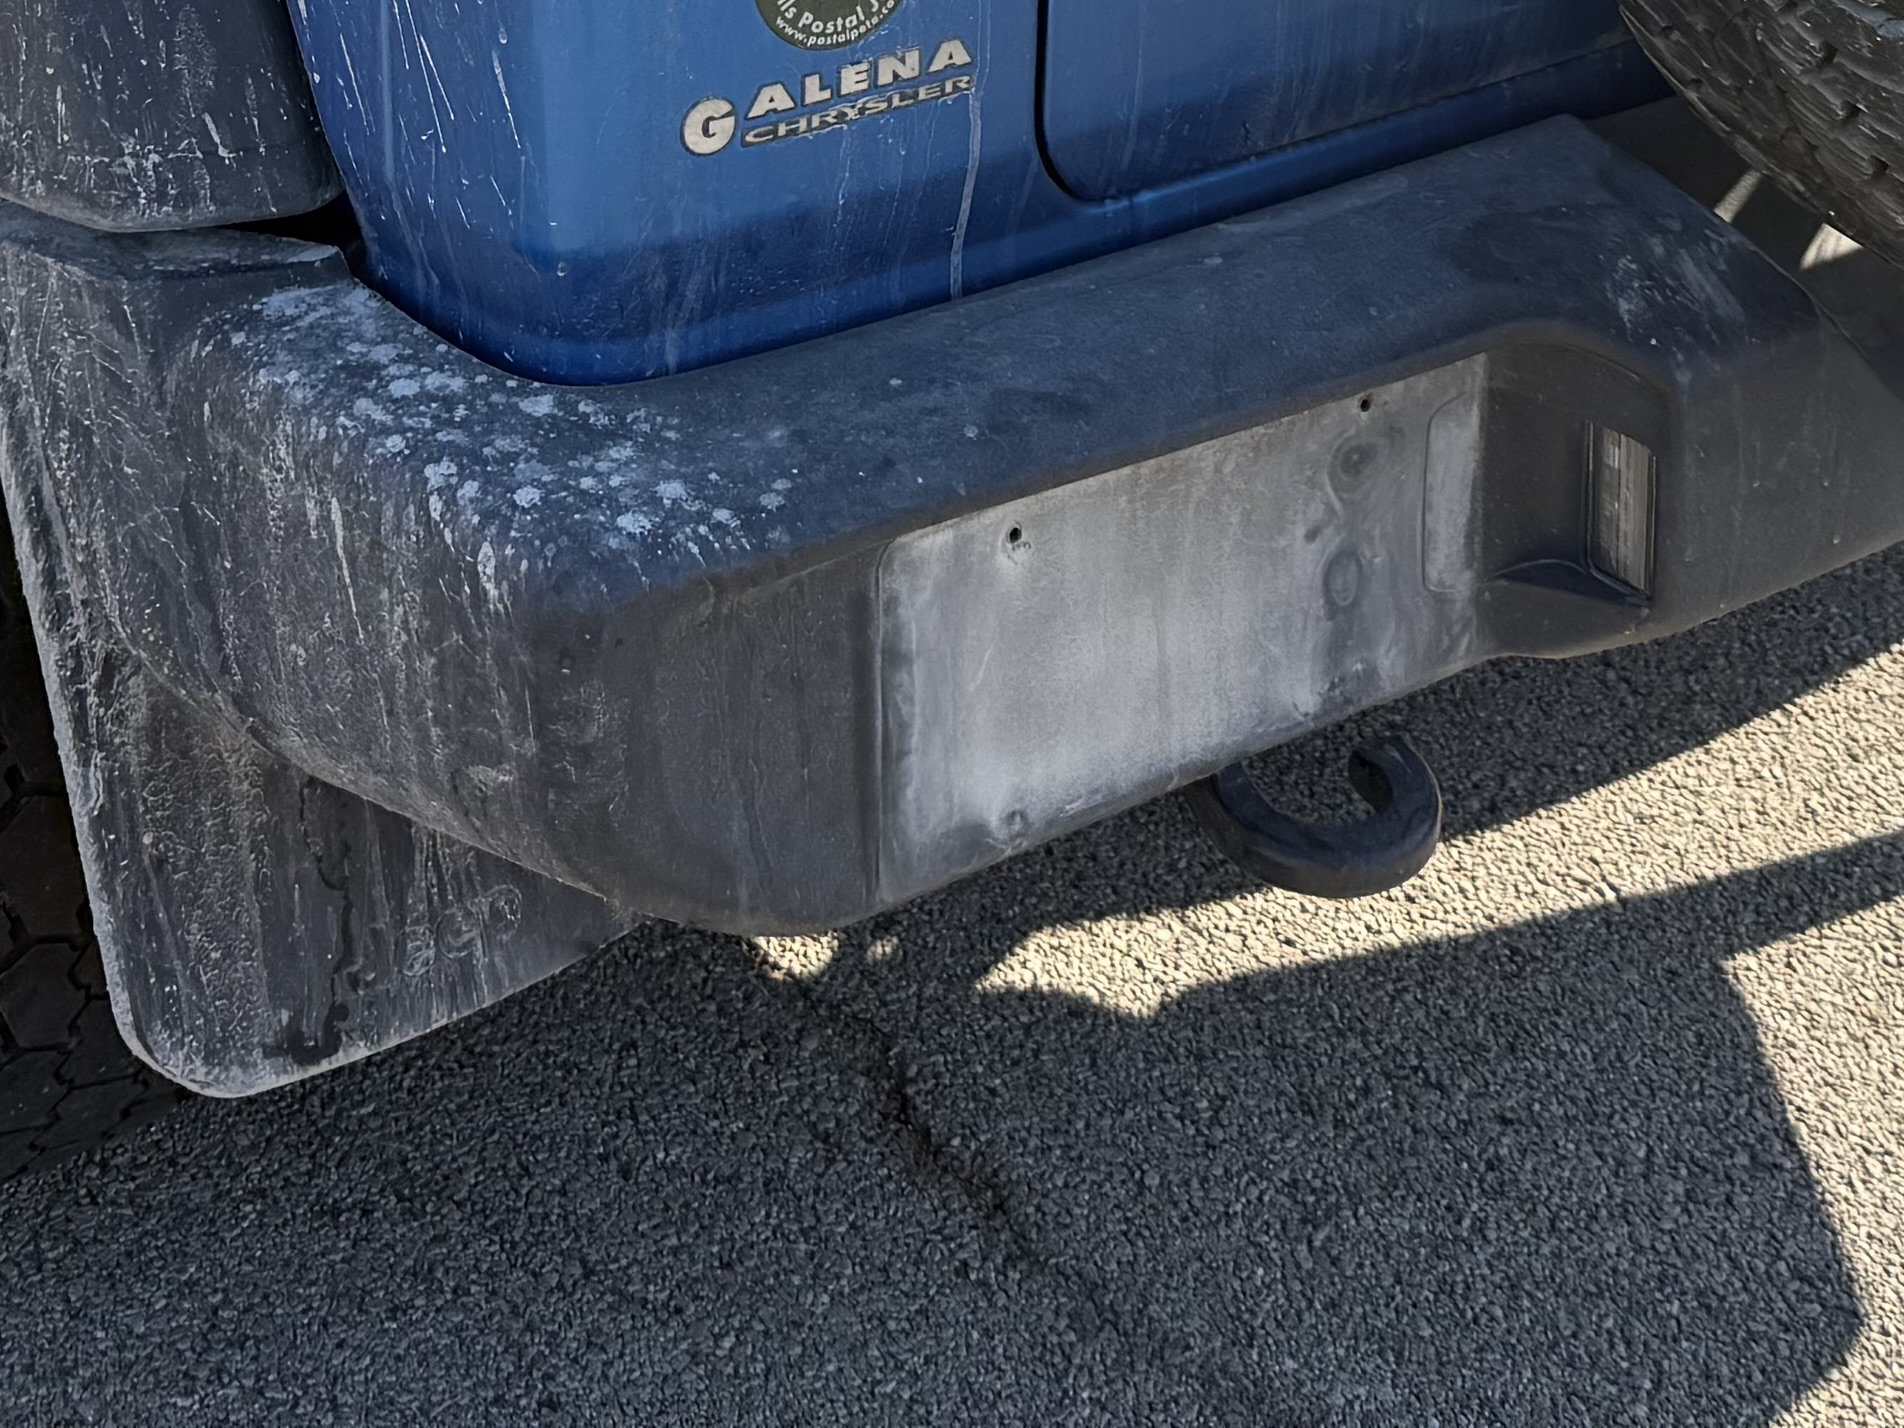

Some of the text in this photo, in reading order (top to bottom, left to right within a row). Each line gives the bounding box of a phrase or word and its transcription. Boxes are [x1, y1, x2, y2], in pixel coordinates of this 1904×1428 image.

[798, 6, 865, 33] Postal
[682, 39, 972, 155] GALENA
[744, 75, 971, 144] CHRYSLER
